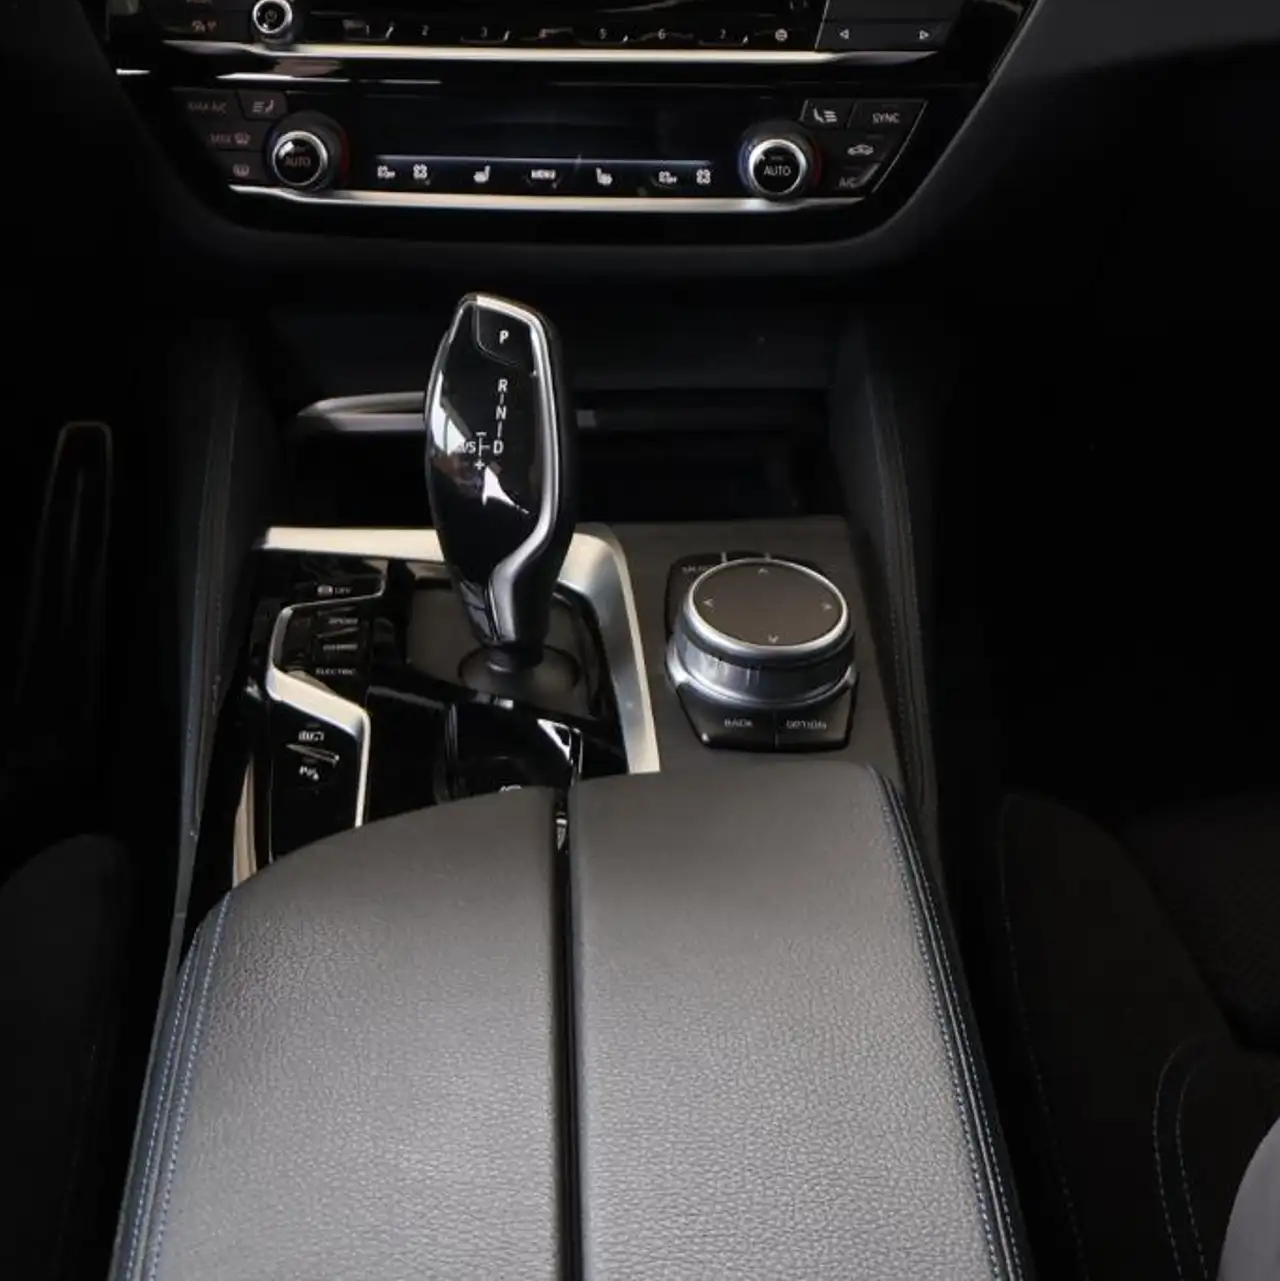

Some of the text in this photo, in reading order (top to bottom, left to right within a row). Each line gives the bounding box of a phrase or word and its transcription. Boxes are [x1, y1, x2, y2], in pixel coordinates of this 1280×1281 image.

[872, 111, 901, 124] SYNC
[283, 155, 312, 169] AUTO
[763, 164, 792, 178] AUTO
[499, 329, 510, 345] P
[497, 378, 508, 393] R
[495, 404, 507, 420] N
[493, 439, 505, 455] D
[723, 718, 828, 731] BACK OPTION
